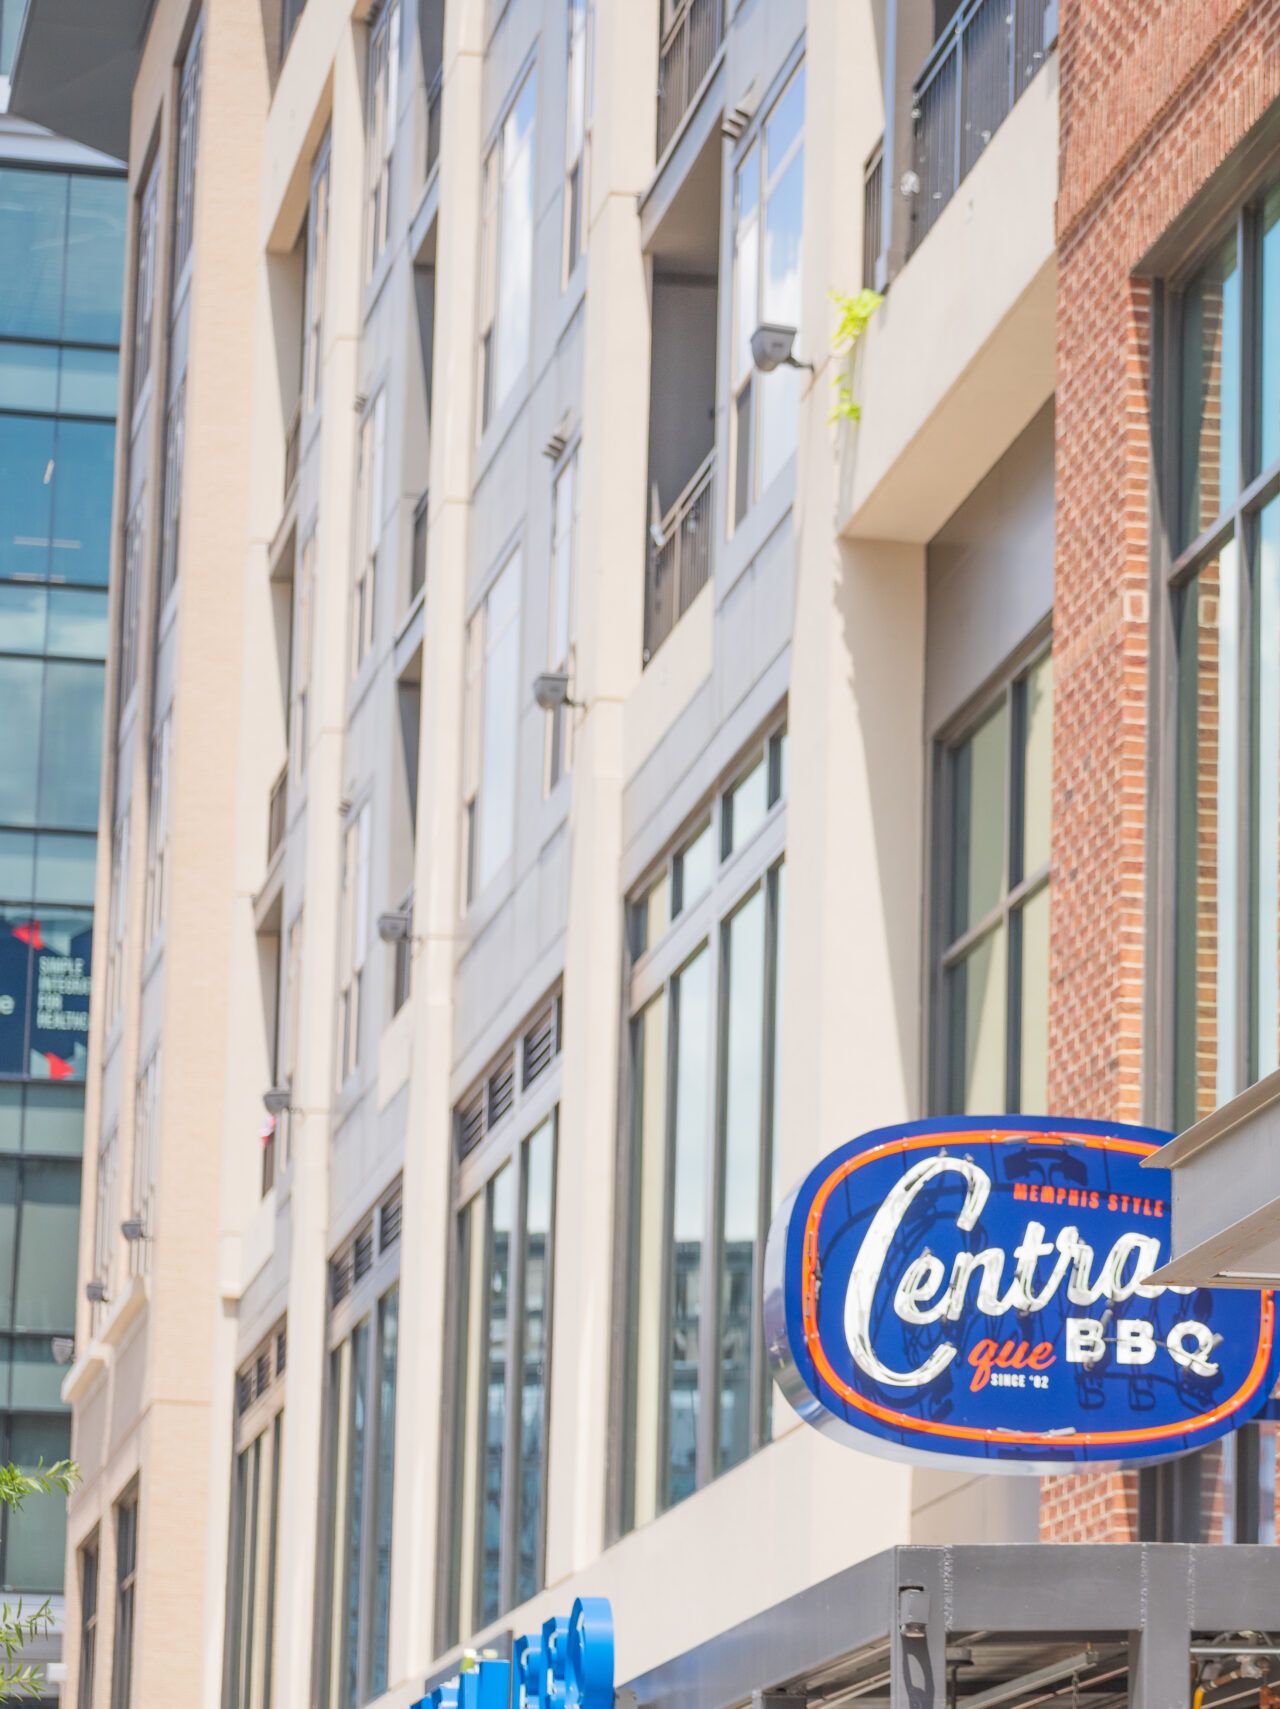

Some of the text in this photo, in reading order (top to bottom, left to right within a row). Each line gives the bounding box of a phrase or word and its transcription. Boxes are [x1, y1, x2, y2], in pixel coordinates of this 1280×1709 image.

[1013, 1183, 1164, 1217] MEMPHIS STYLE
[843, 1154, 1198, 1387] Centra
[967, 1317, 1220, 1393] que BBQ
[990, 1373, 1026, 1388] SINCE
